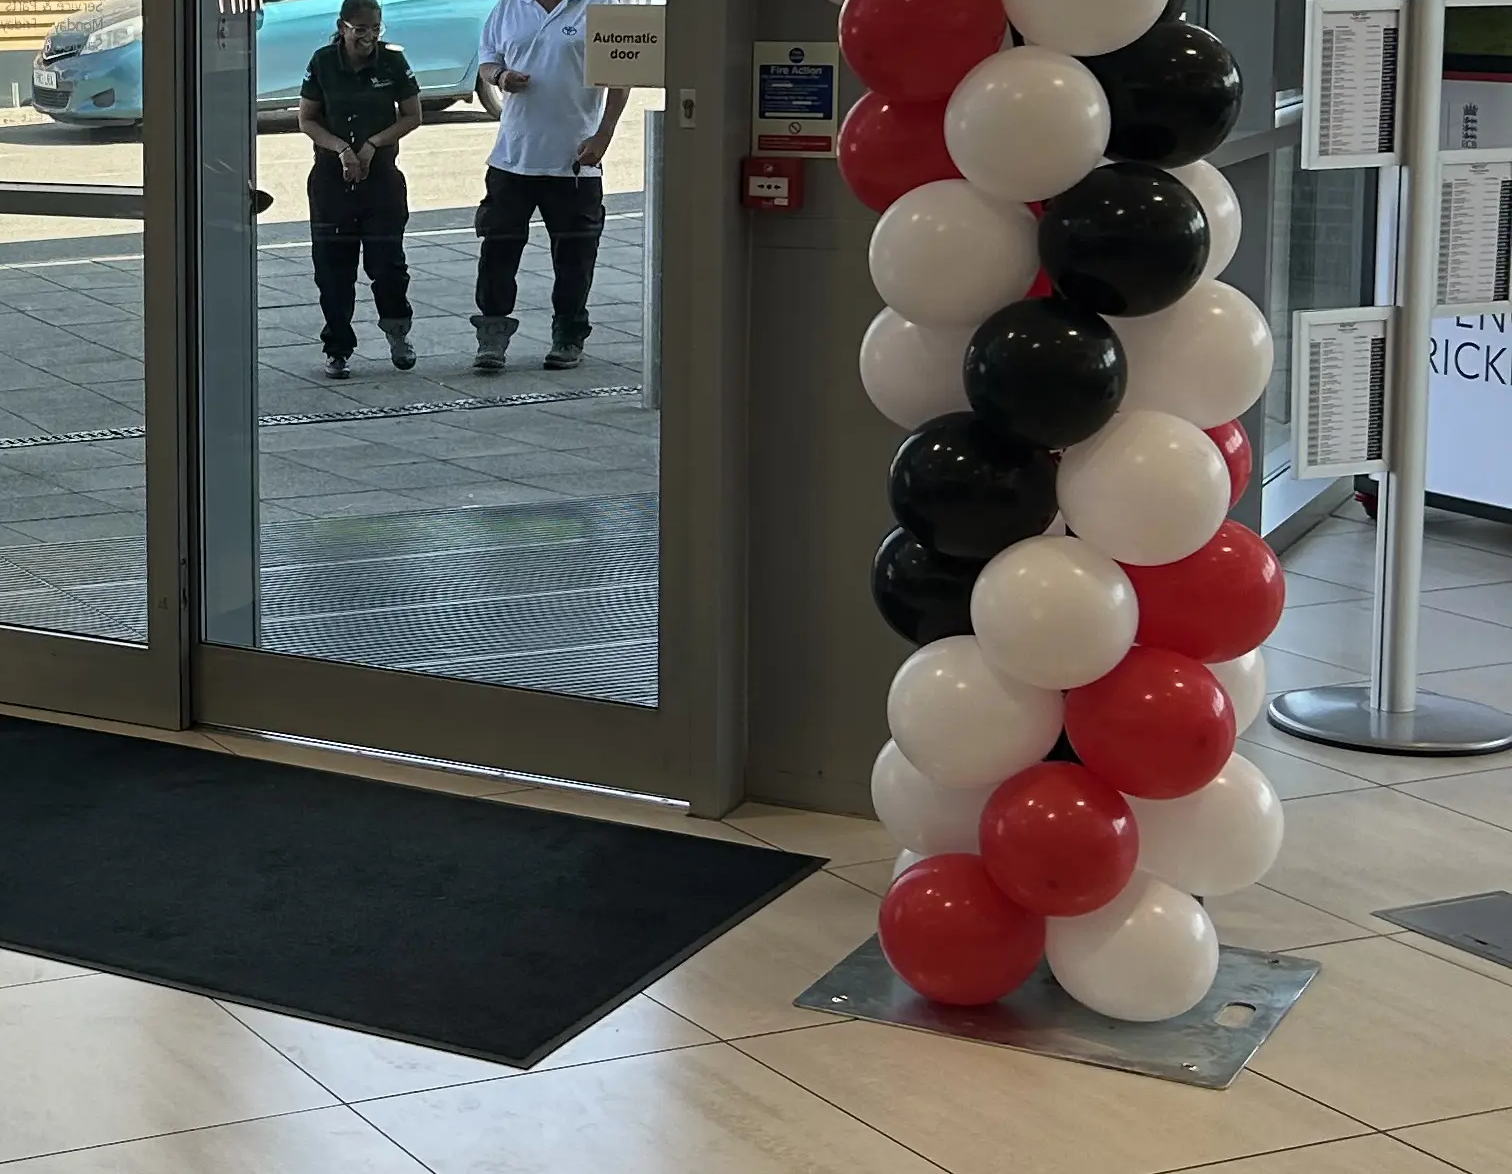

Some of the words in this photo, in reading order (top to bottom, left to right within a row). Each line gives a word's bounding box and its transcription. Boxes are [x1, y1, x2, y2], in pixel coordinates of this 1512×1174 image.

[592, 31, 658, 44] Automatic
[609, 48, 640, 60] door
[770, 65, 789, 75] Fire
[791, 65, 823, 75] Action
